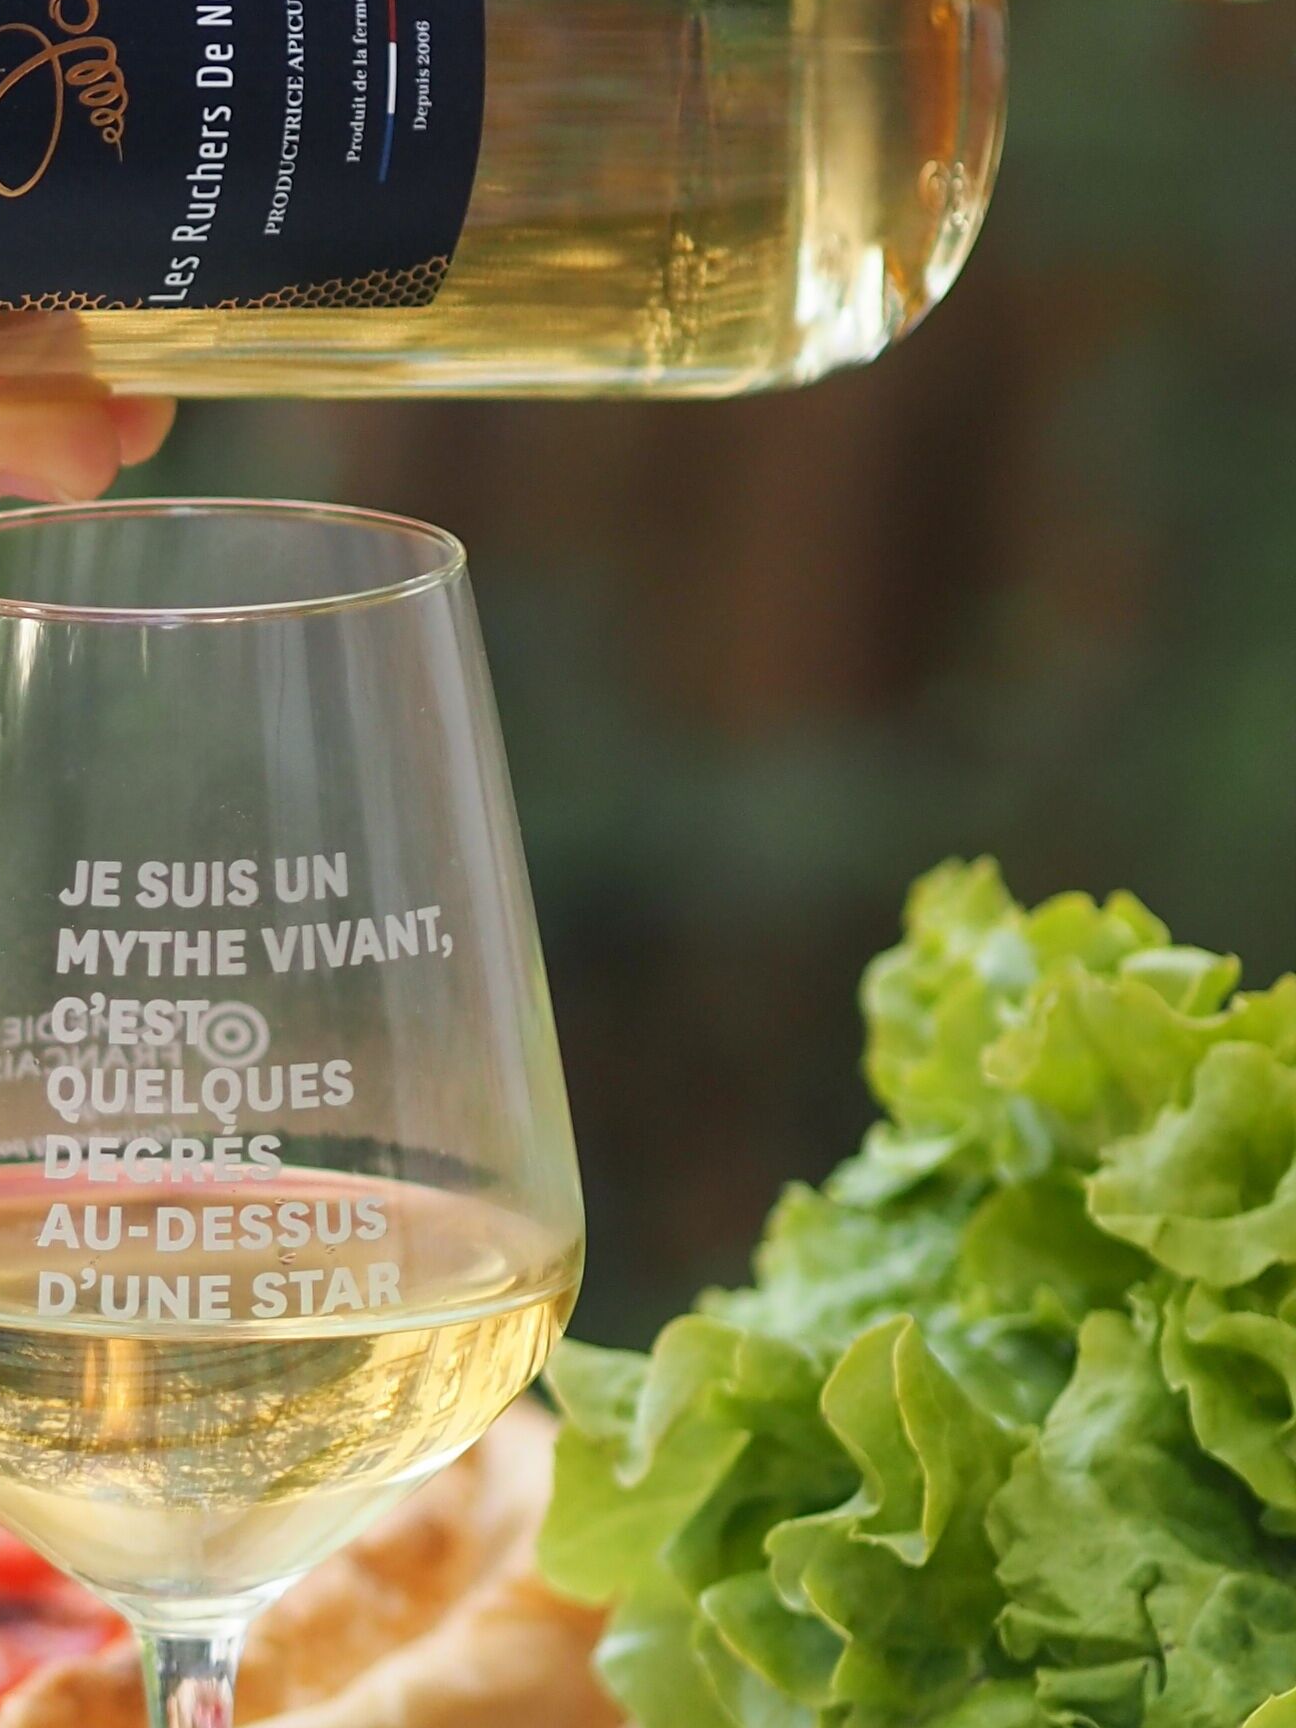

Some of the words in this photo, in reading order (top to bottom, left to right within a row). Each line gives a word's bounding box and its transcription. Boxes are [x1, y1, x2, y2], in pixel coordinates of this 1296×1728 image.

[196, 43, 235, 87] De
[348, 47, 369, 65] la
[412, 20, 432, 65] 2006
[348, 68, 369, 91] de
[411, 68, 433, 130] Depuis
[261, 75, 305, 235] PRODUCTRICE
[344, 96, 369, 162] Produit
[170, 105, 233, 242] Ruchers
[149, 256, 202, 302] Les
[57, 860, 121, 908] JE
[136, 859, 259, 908] SUIS
[275, 851, 348, 904] UN
[55, 927, 247, 978] MYTHE
[261, 905, 453, 974] VIVANT,
[45, 1059, 355, 1126] QUELQUES
[43, 1123, 283, 1184] DEGRÉS
[36, 1196, 388, 1254] AU-DESSUS
[249, 1263, 402, 1319] STAR
